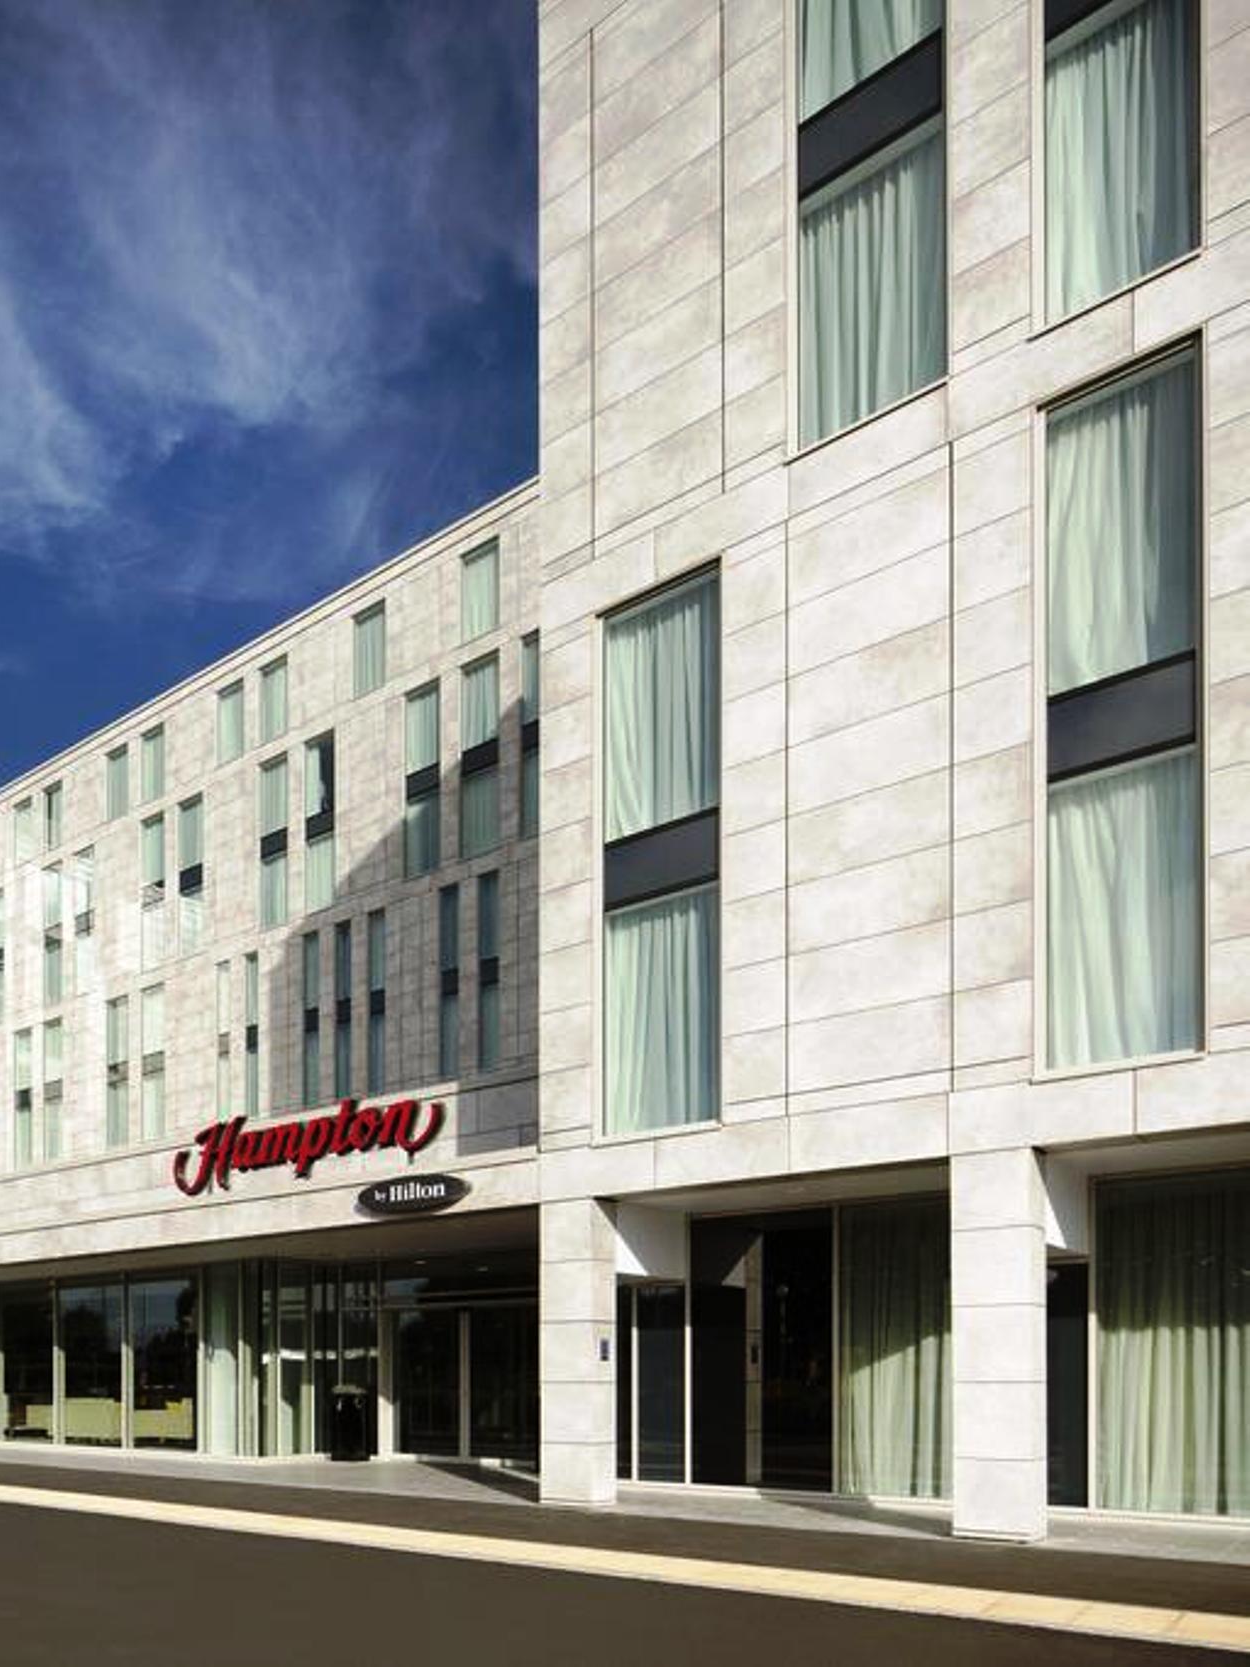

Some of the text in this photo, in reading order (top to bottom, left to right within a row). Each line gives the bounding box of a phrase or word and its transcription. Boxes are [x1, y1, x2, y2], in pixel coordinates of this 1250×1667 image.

[173, 1097, 447, 1197] Hampton
[374, 1182, 446, 1202] by Hilton
